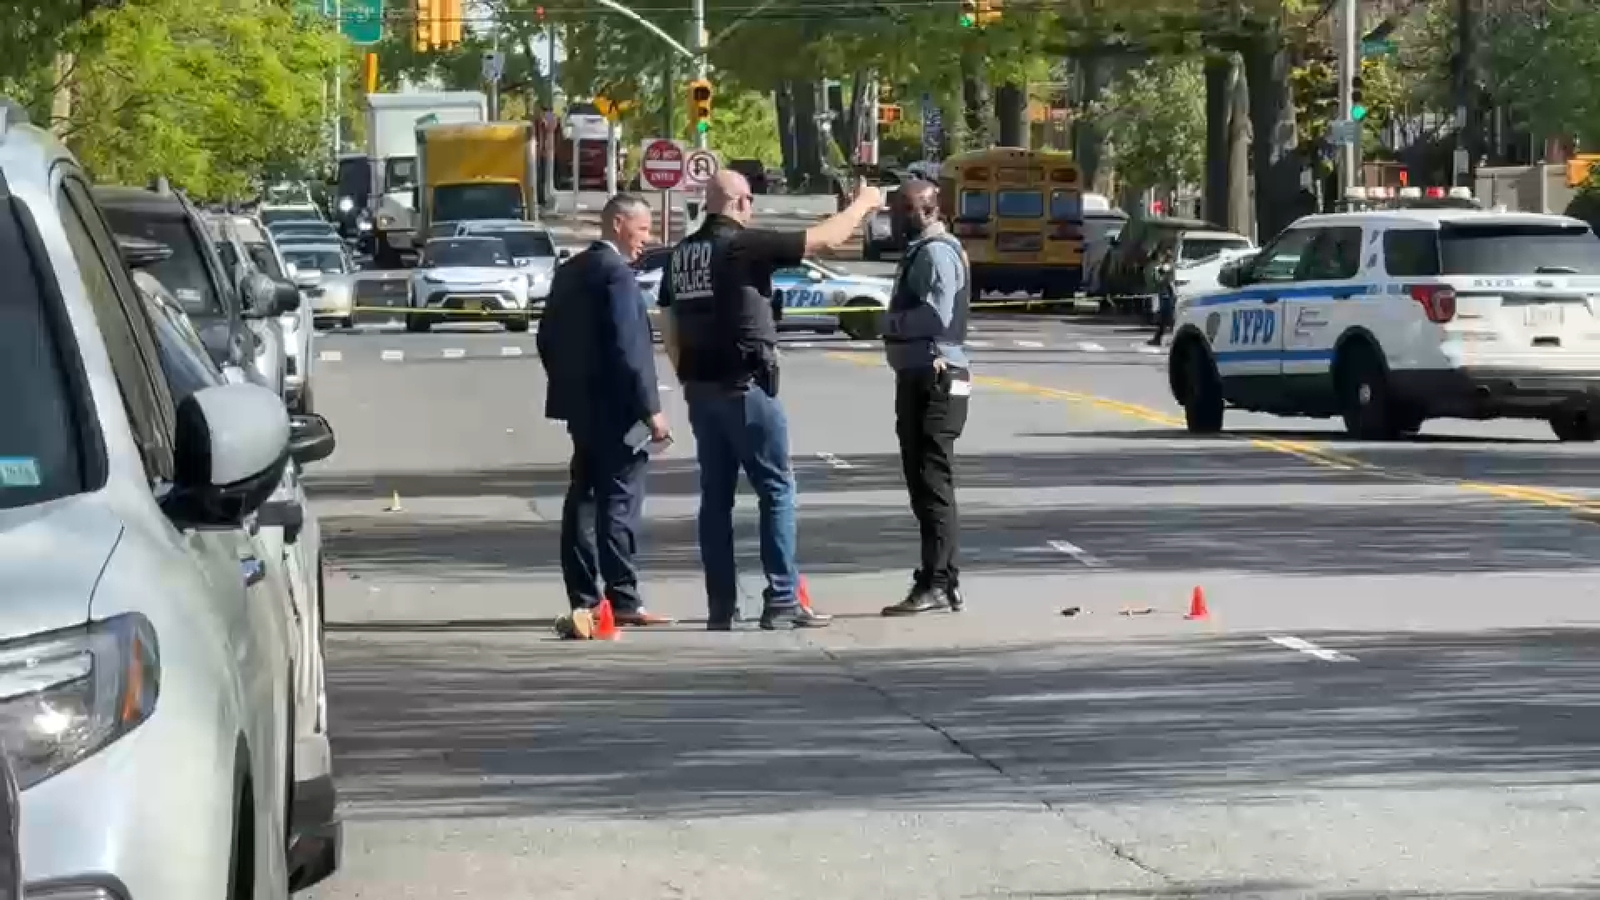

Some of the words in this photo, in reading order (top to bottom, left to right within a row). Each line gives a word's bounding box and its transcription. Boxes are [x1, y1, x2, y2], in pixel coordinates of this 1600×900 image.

[651, 172, 675, 181] ENTER
[671, 242, 712, 273] NYPD
[671, 269, 712, 293] POLICE
[781, 289, 824, 307] YPD
[1229, 309, 1276, 345] NYPD
